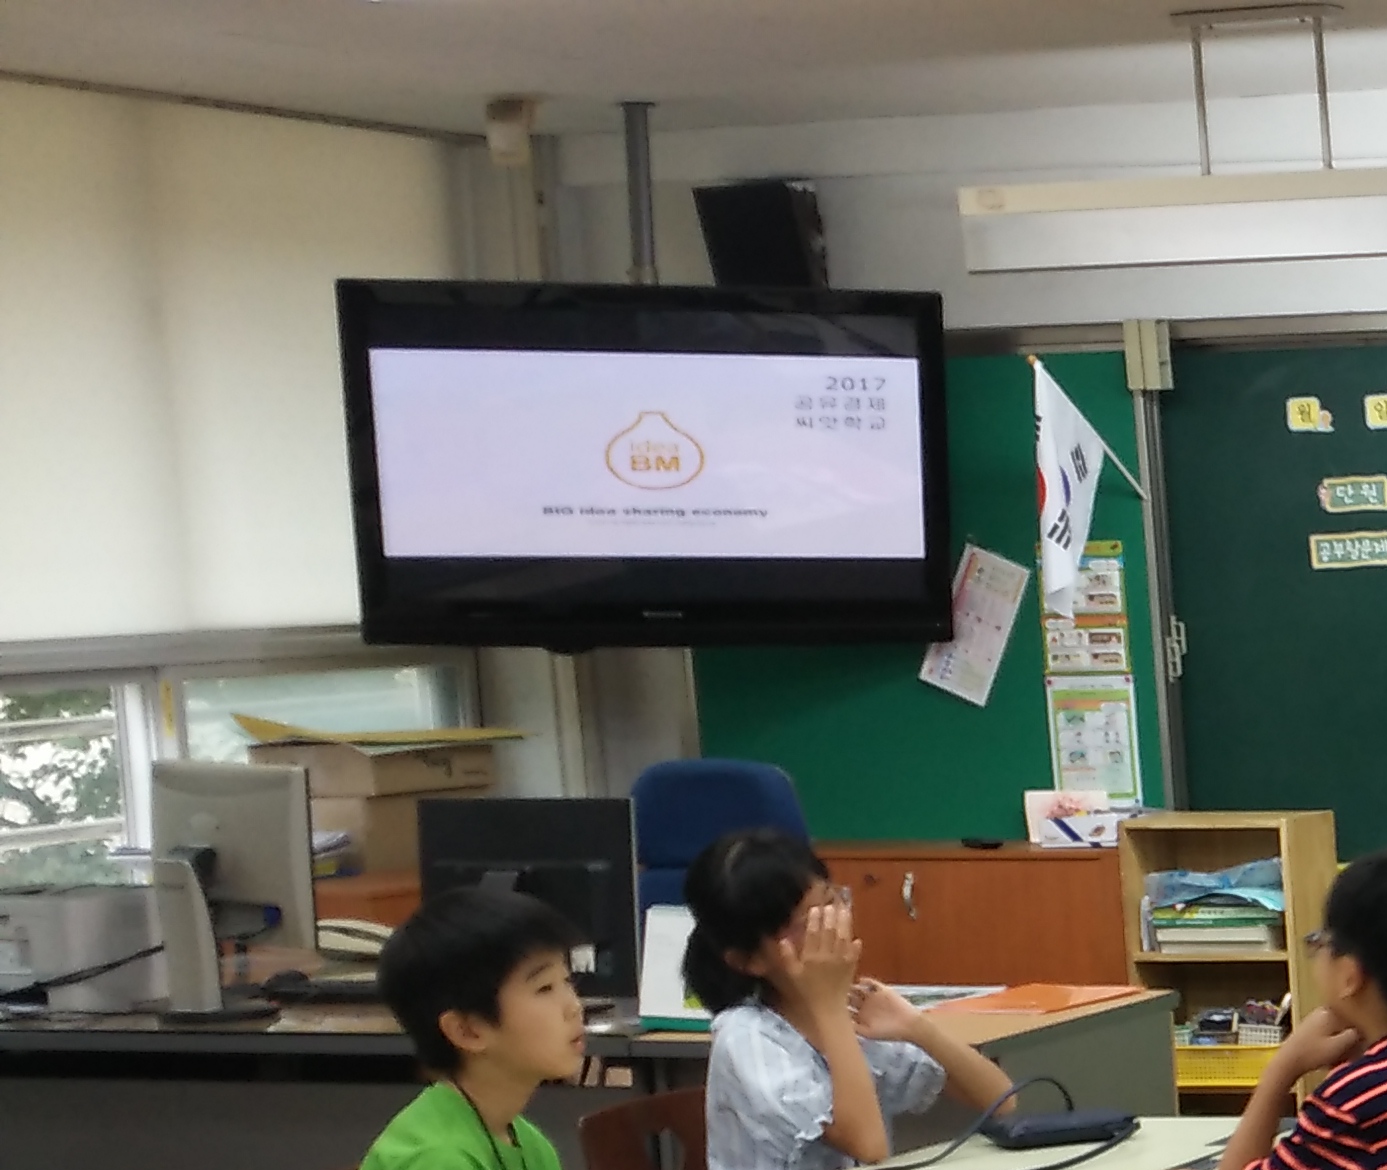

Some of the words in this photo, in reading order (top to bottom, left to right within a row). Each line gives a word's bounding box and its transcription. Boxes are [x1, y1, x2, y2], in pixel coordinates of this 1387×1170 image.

[825, 375, 887, 391] 2017
[631, 455, 680, 472] BM
[1335, 482, 1378, 505] 단원
[692, 506, 768, 518] economy
